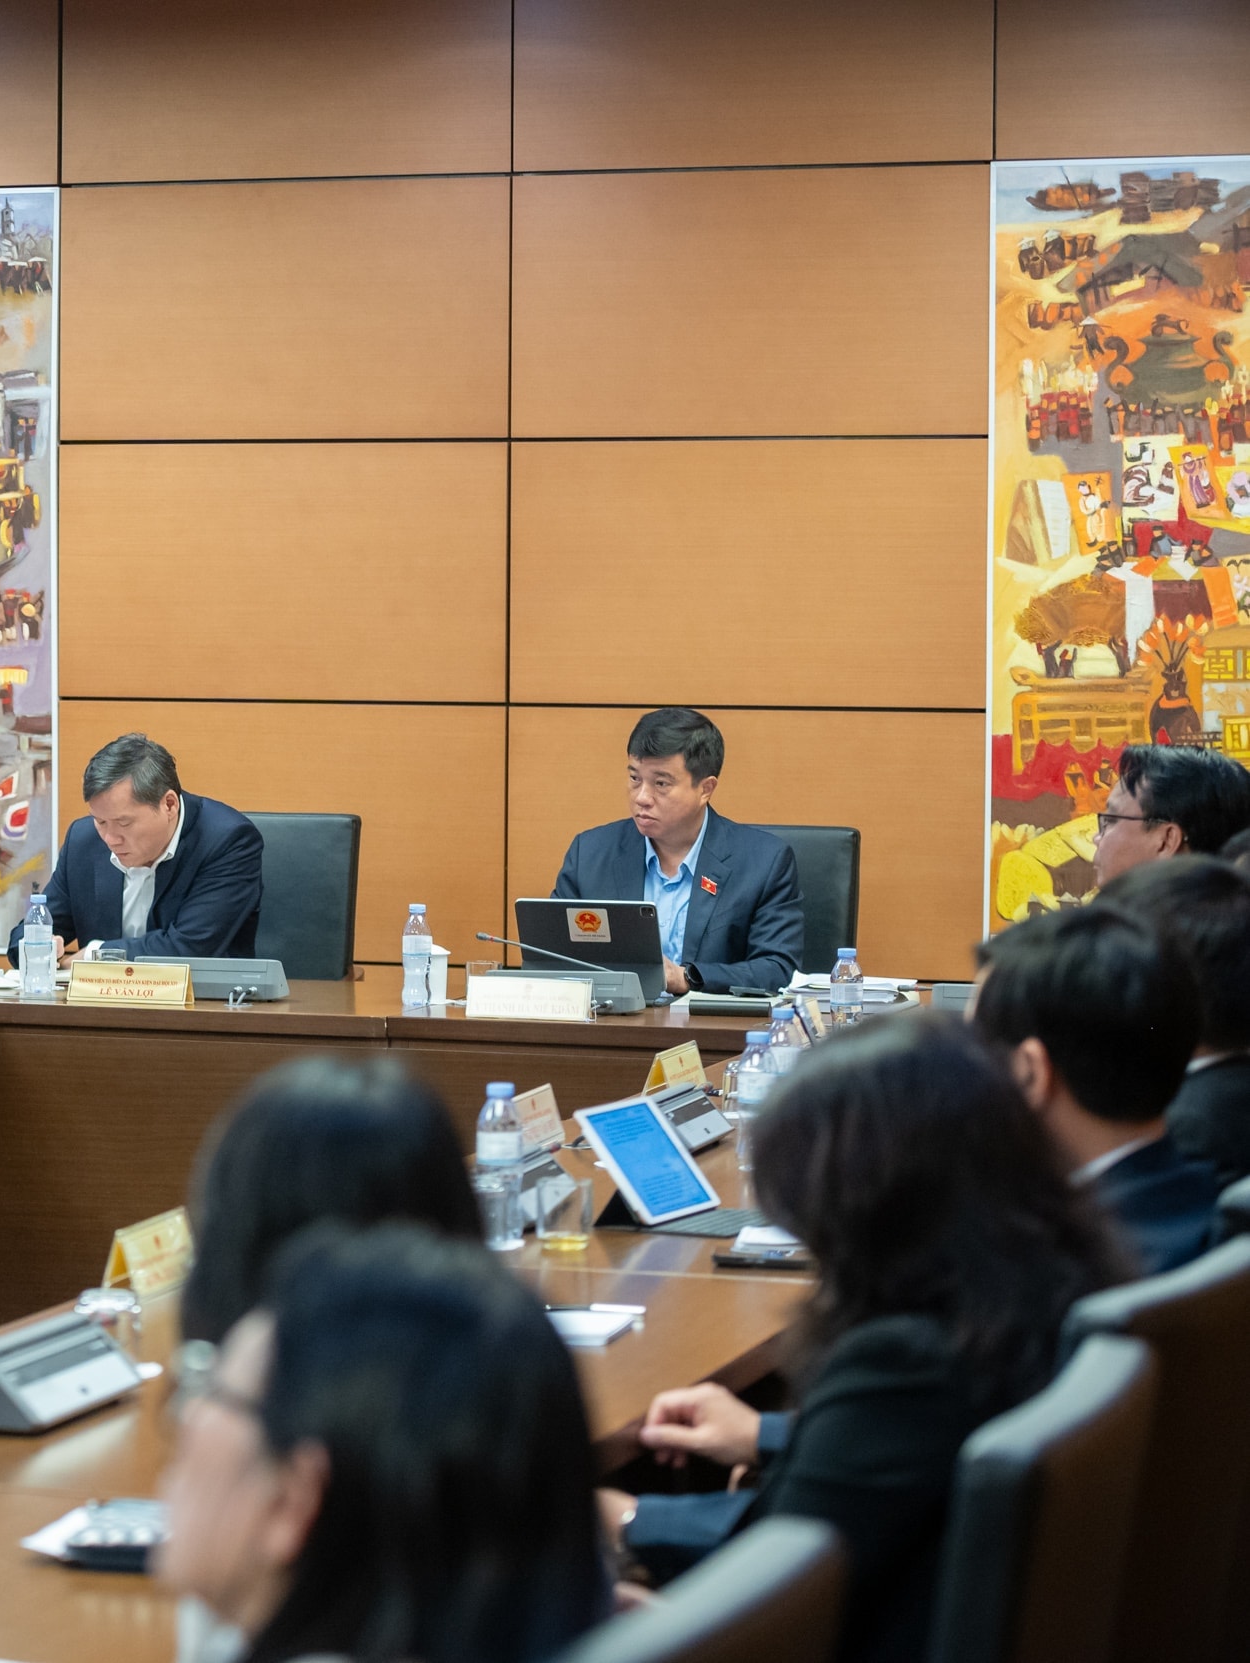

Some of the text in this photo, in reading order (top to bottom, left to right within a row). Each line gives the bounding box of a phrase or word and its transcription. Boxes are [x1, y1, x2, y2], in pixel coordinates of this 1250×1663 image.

[100, 986, 154, 998] LÊ VĂN LỢI
